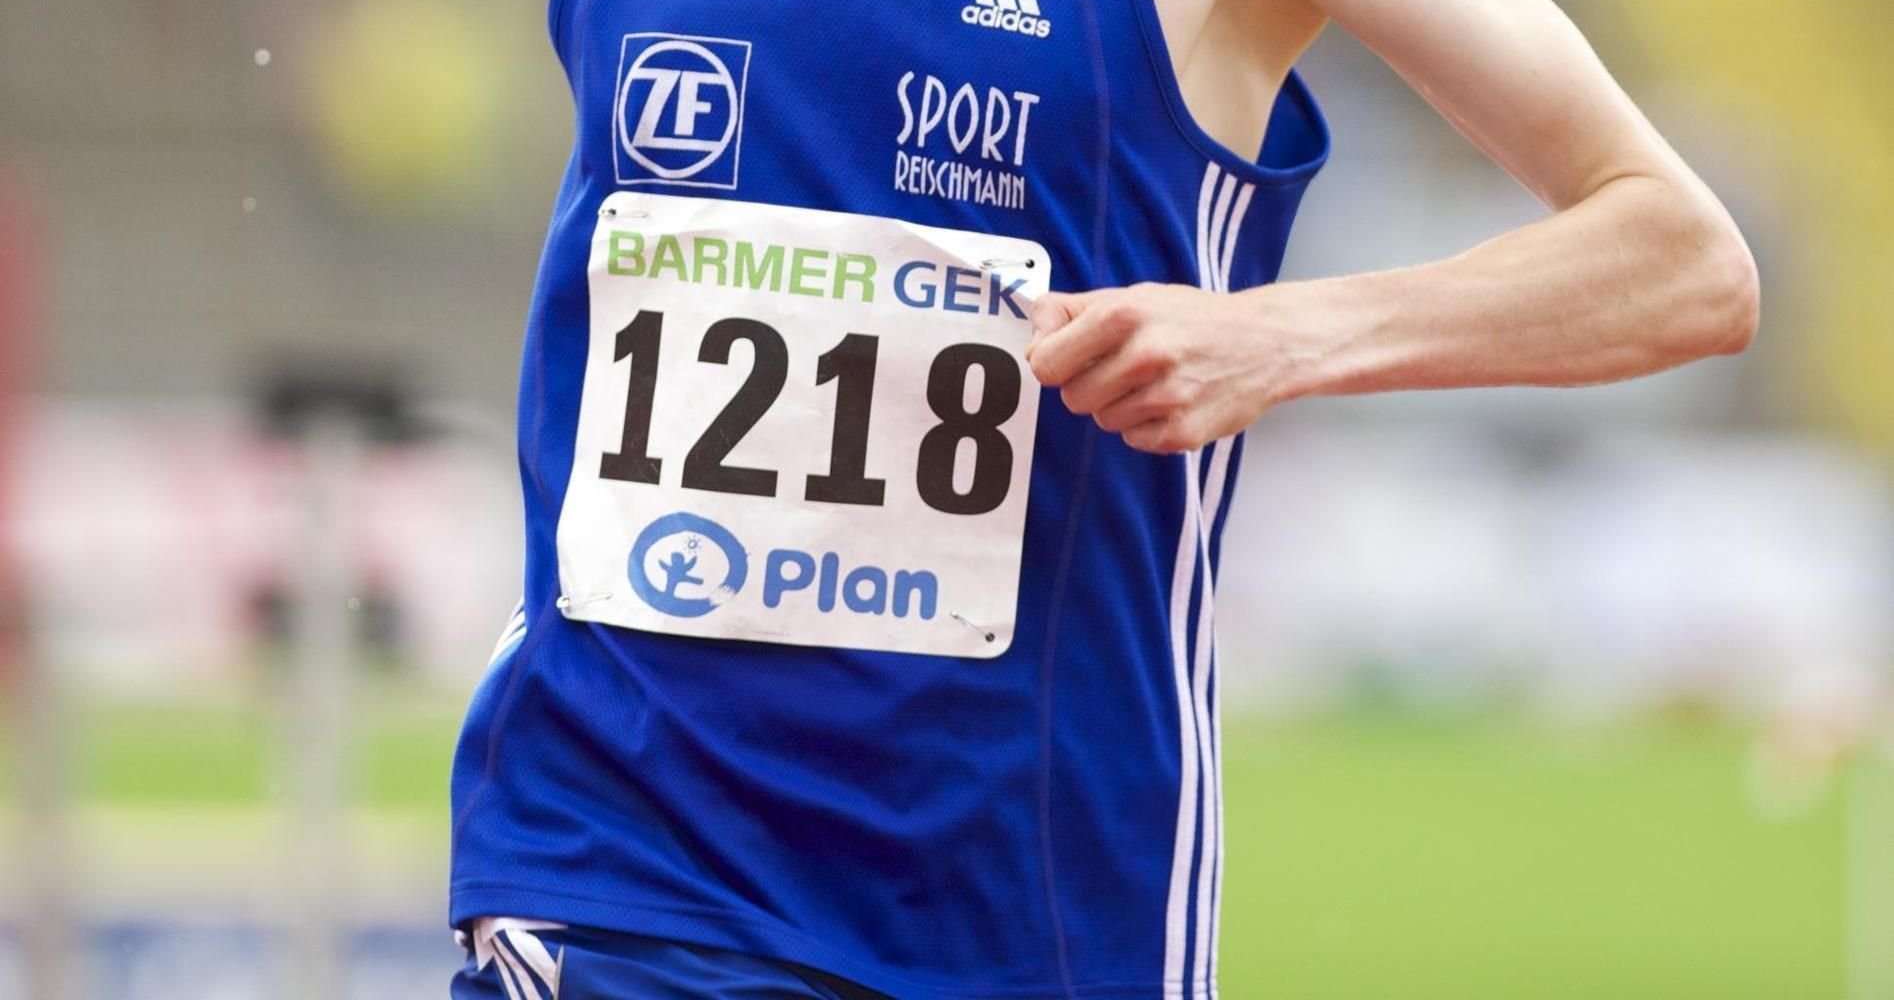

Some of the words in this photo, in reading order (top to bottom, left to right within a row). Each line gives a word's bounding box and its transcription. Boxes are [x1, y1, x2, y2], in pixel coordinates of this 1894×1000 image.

[961, 4, 1051, 38] adidas
[632, 67, 728, 150] ZF
[896, 70, 1040, 166] SPORT
[894, 150, 1025, 209] REISCHMANN
[607, 230, 878, 302] BARMER
[893, 260, 1029, 320] GEK
[598, 309, 1022, 516] 1218
[762, 548, 939, 620] Plan
